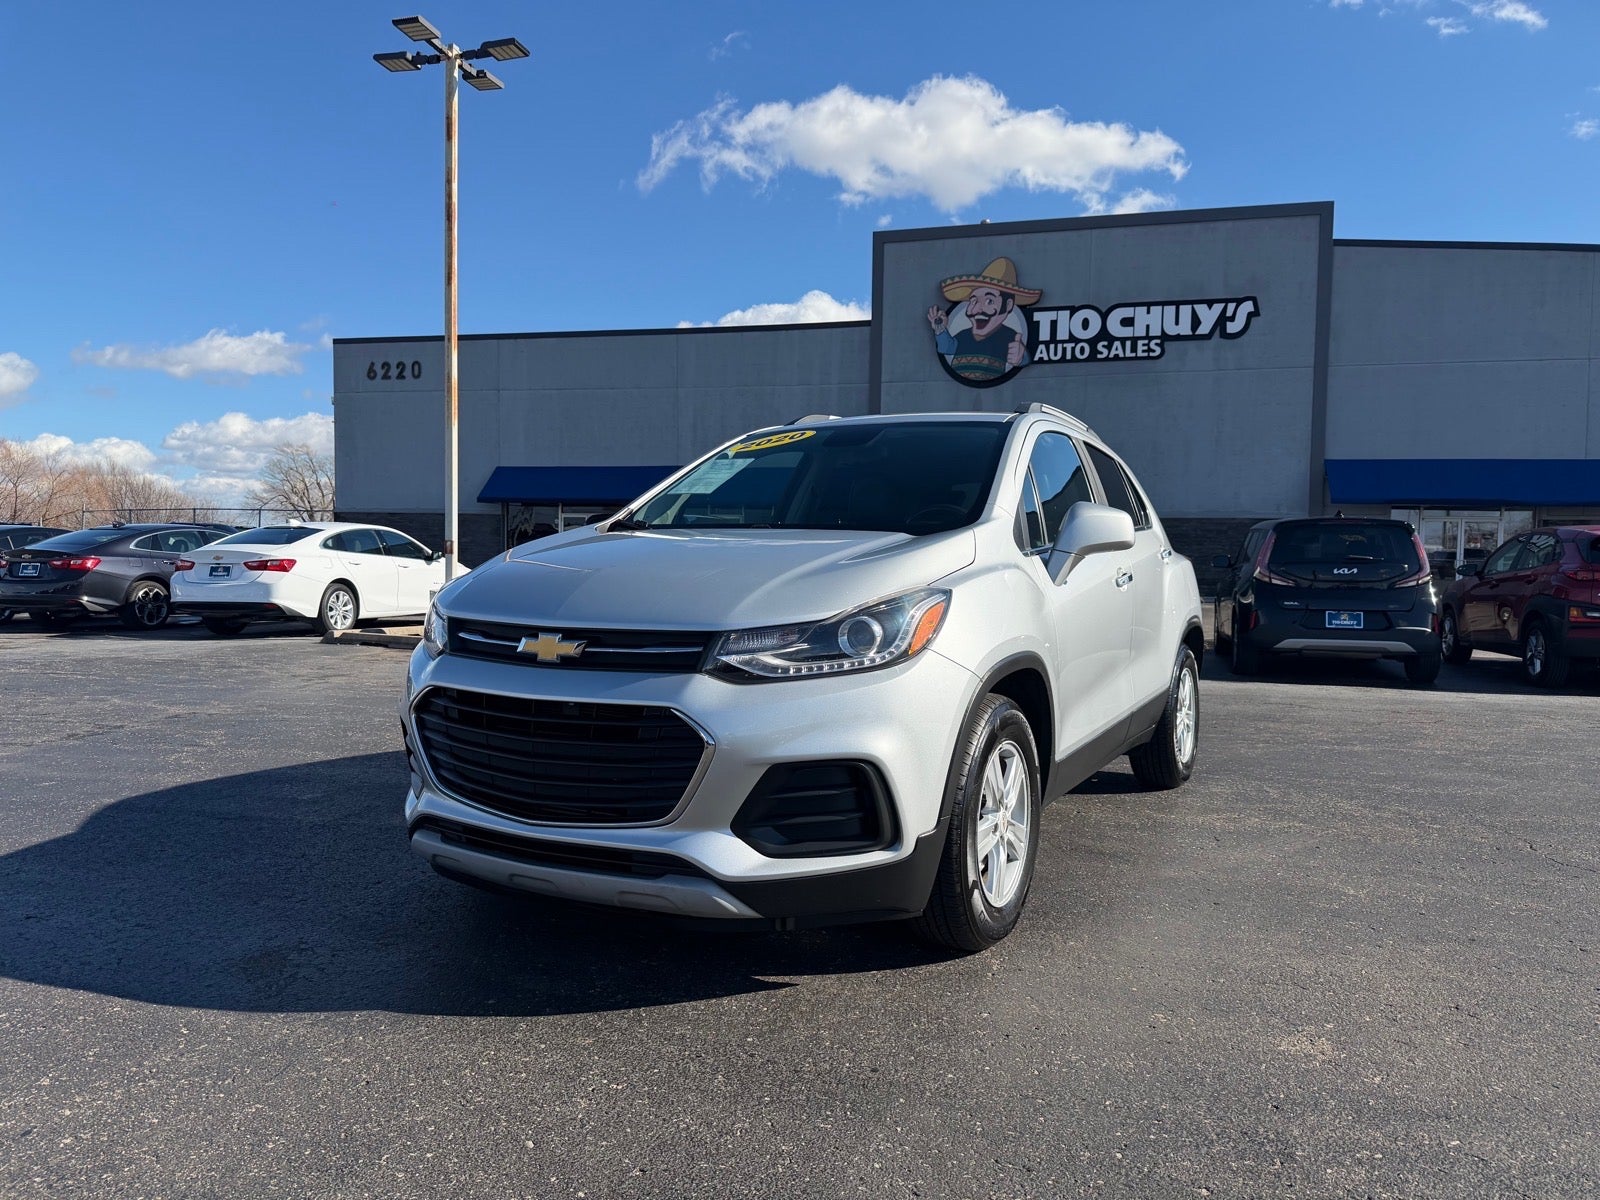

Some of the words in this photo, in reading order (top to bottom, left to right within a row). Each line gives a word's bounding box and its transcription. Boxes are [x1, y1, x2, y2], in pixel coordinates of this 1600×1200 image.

[1033, 308, 1102, 341] TIO
[1106, 300, 1255, 338] CHUY'S
[1033, 342, 1090, 361] AUTO
[1096, 339, 1162, 359] SALES
[366, 361, 422, 380] 6220
[739, 431, 807, 450] 2020
